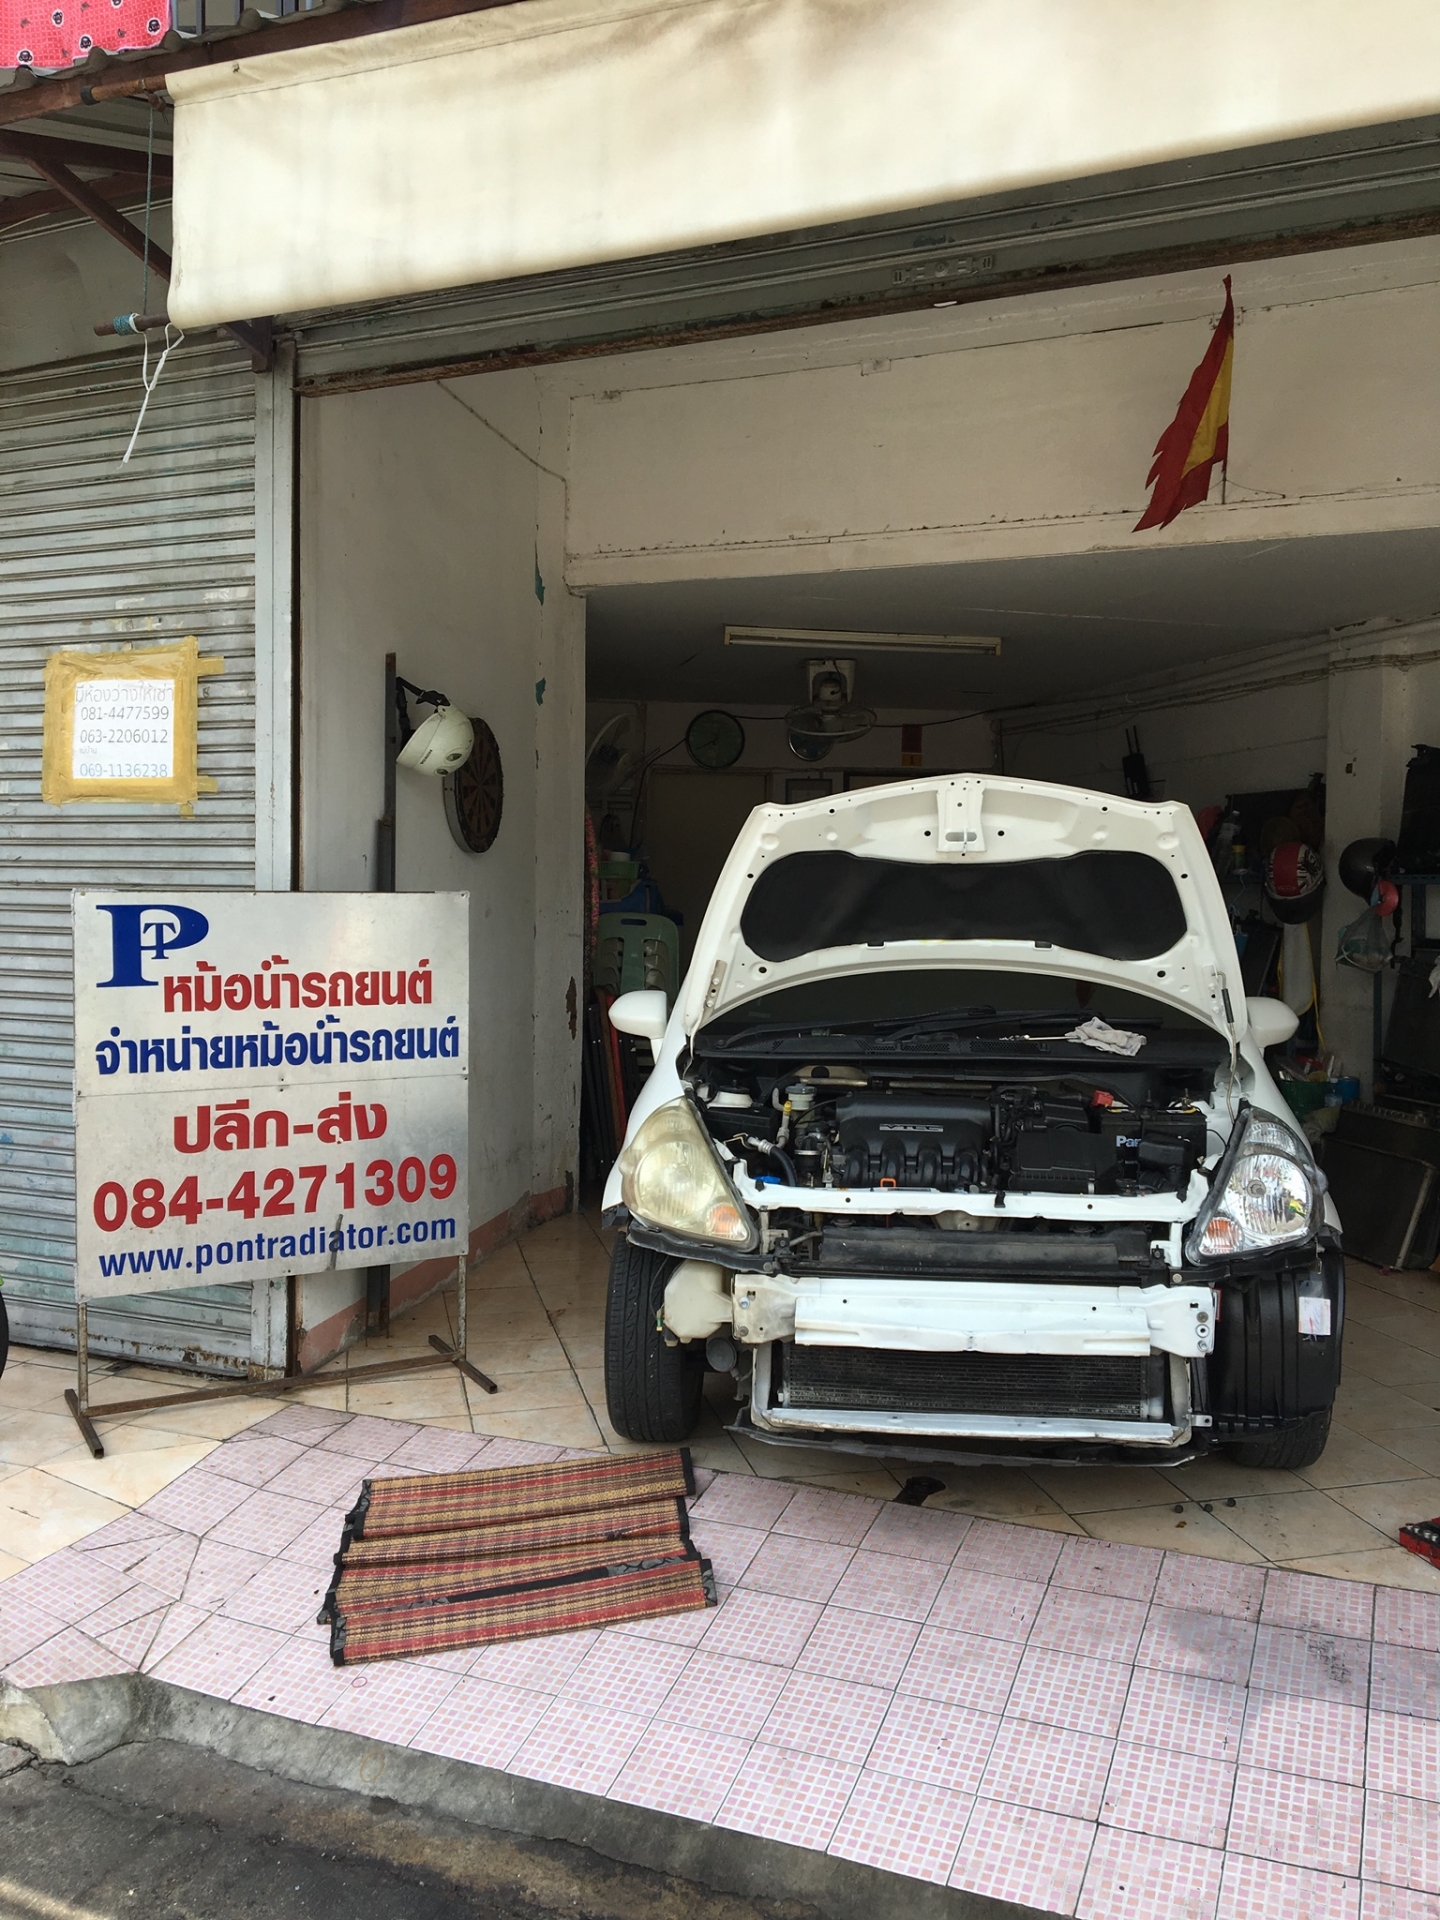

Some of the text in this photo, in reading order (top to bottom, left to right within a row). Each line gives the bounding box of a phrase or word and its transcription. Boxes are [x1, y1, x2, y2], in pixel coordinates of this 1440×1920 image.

[79, 728, 168, 744] 063-2206012
[81, 706, 169, 720] 081-4477599
[79, 762, 168, 778] 069-1136238
[163, 954, 433, 1013] หม้อน้ำรถยนต์
[95, 1014, 460, 1075] จำหน่ายหม้อน้ำรถยนต์
[173, 1091, 388, 1154] ปลีก-ส่ง
[93, 1153, 457, 1232] 084-4271309
[98, 1217, 457, 1278] www.pontradiator.com
